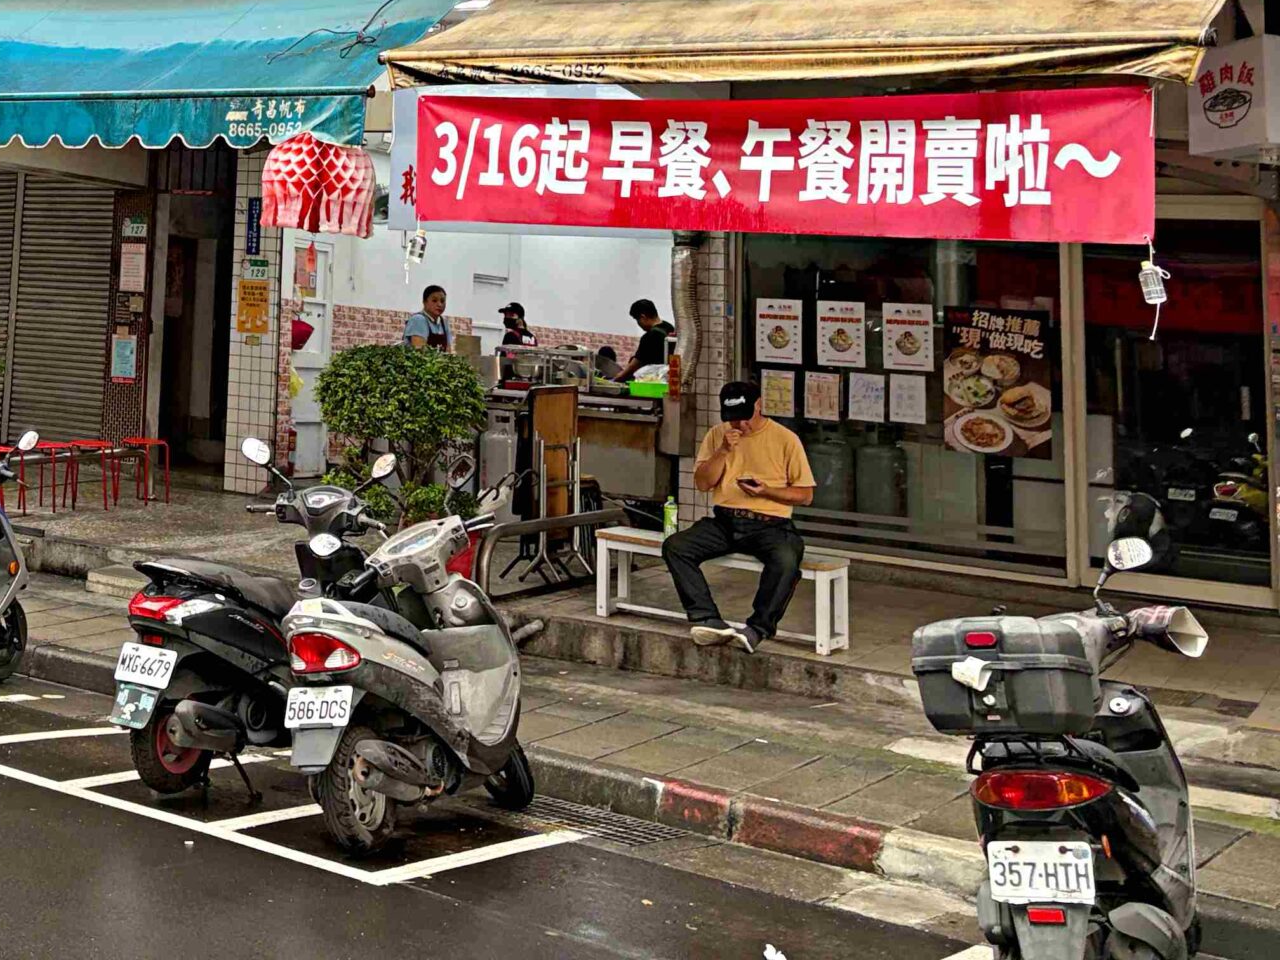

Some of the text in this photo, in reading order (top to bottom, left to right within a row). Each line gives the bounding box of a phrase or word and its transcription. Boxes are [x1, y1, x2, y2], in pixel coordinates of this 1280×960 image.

[229, 121, 303, 138] 8665-0952
[431, 117, 590, 200] 3/16起
[130, 225, 144, 235] 127
[250, 268, 266, 278] 129
[972, 309, 1041, 337] 招牌推薦
[993, 860, 1091, 890] 357-HTH
